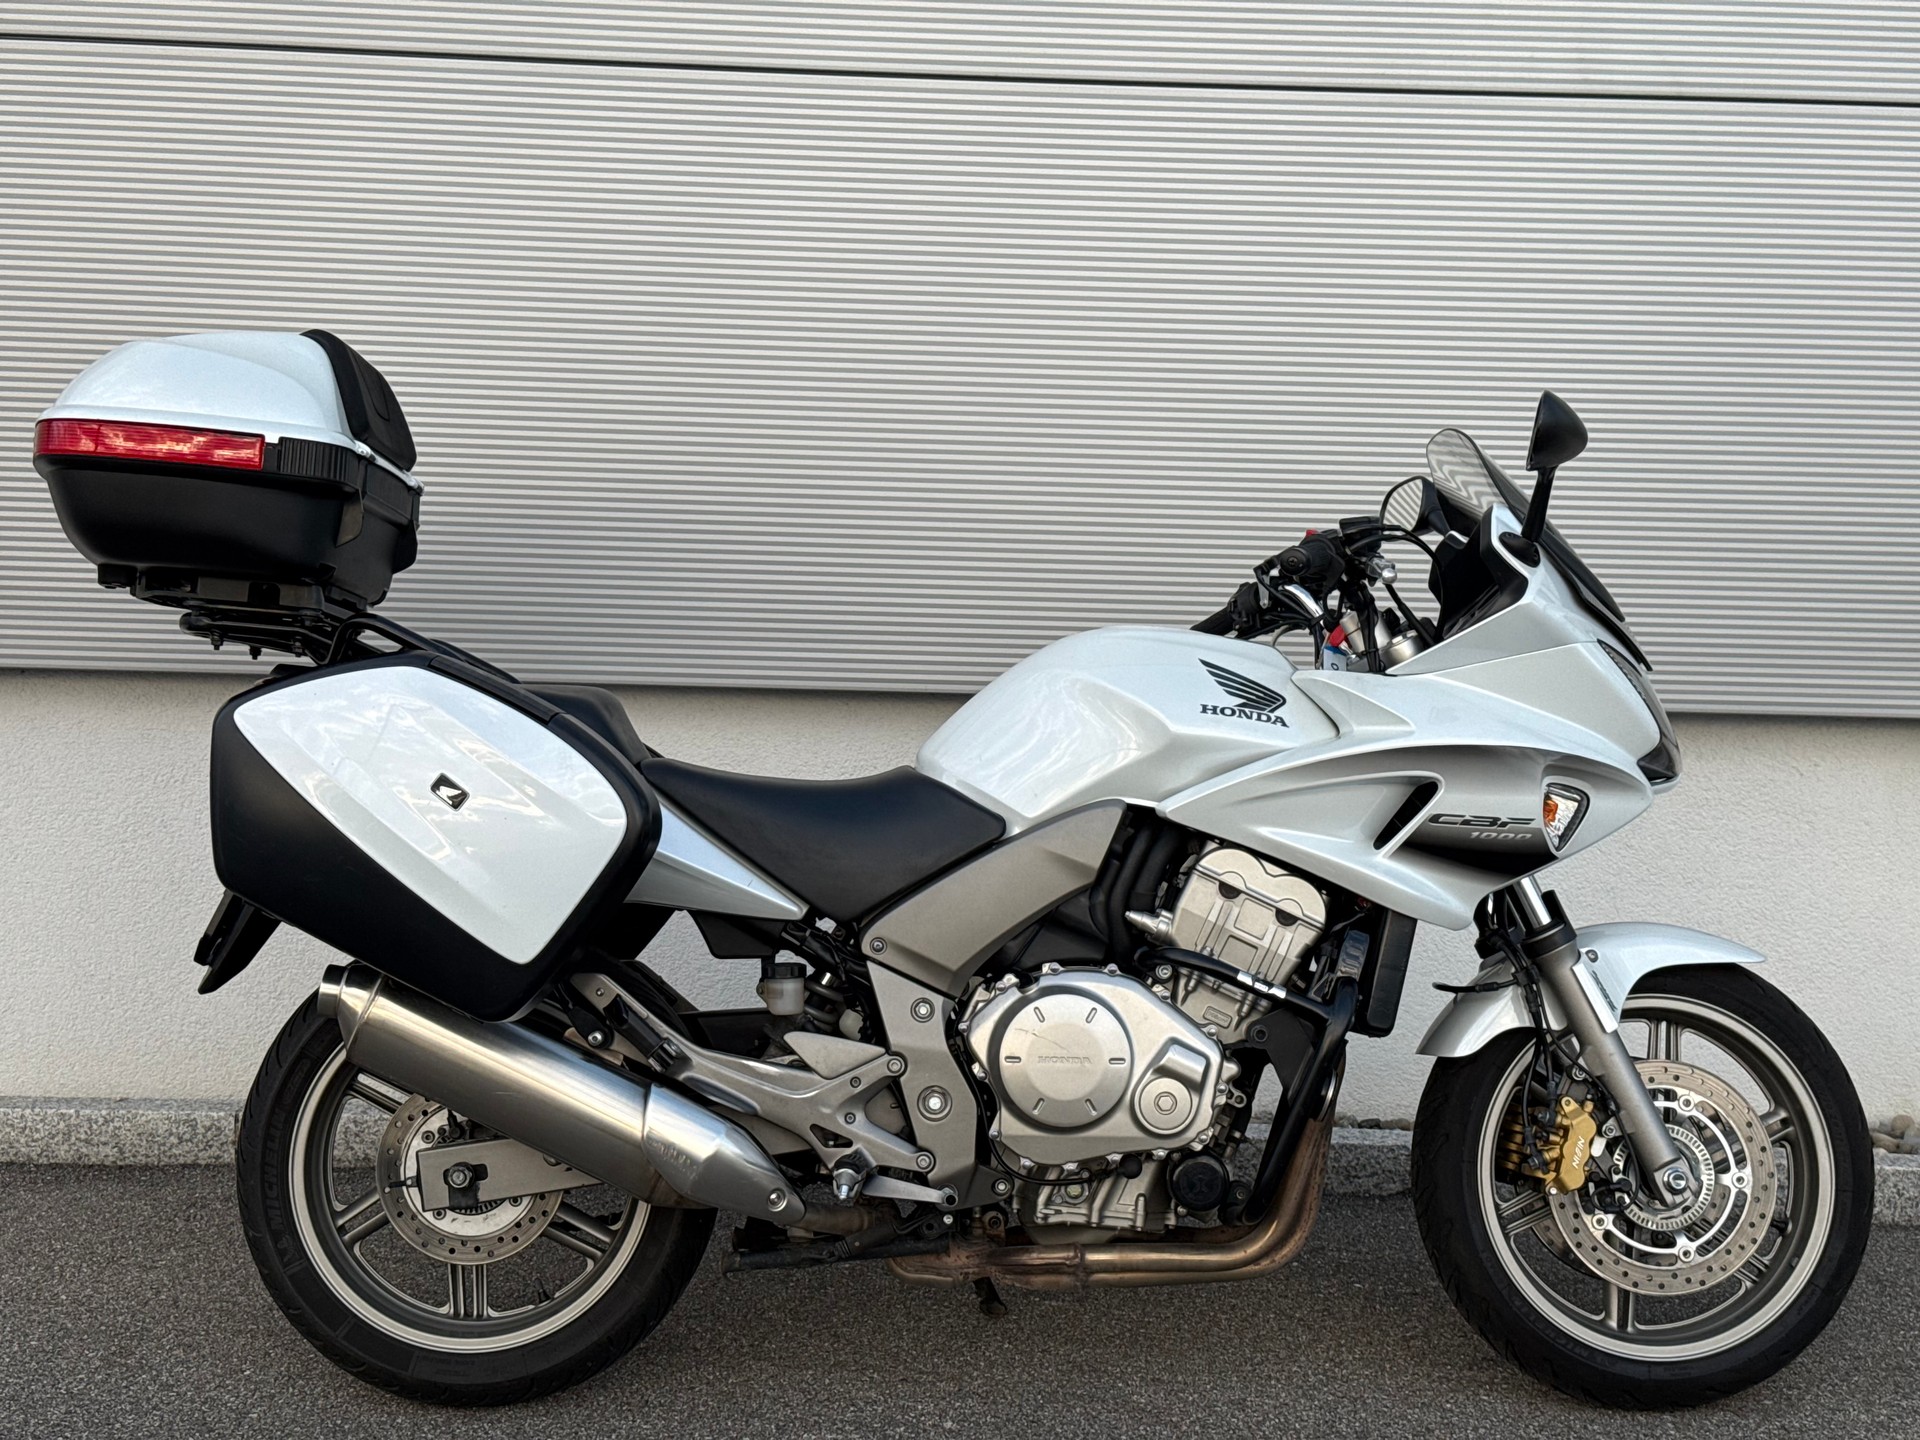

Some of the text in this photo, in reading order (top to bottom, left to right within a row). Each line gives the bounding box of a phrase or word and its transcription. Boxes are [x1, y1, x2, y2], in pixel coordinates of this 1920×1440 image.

[1200, 703, 1290, 728] HONDA
[1428, 813, 1535, 829] CBF
[1470, 831, 1533, 841] 1000
[1037, 1055, 1093, 1065] HONDA
[263, 1106, 287, 1232] MICHELIN
